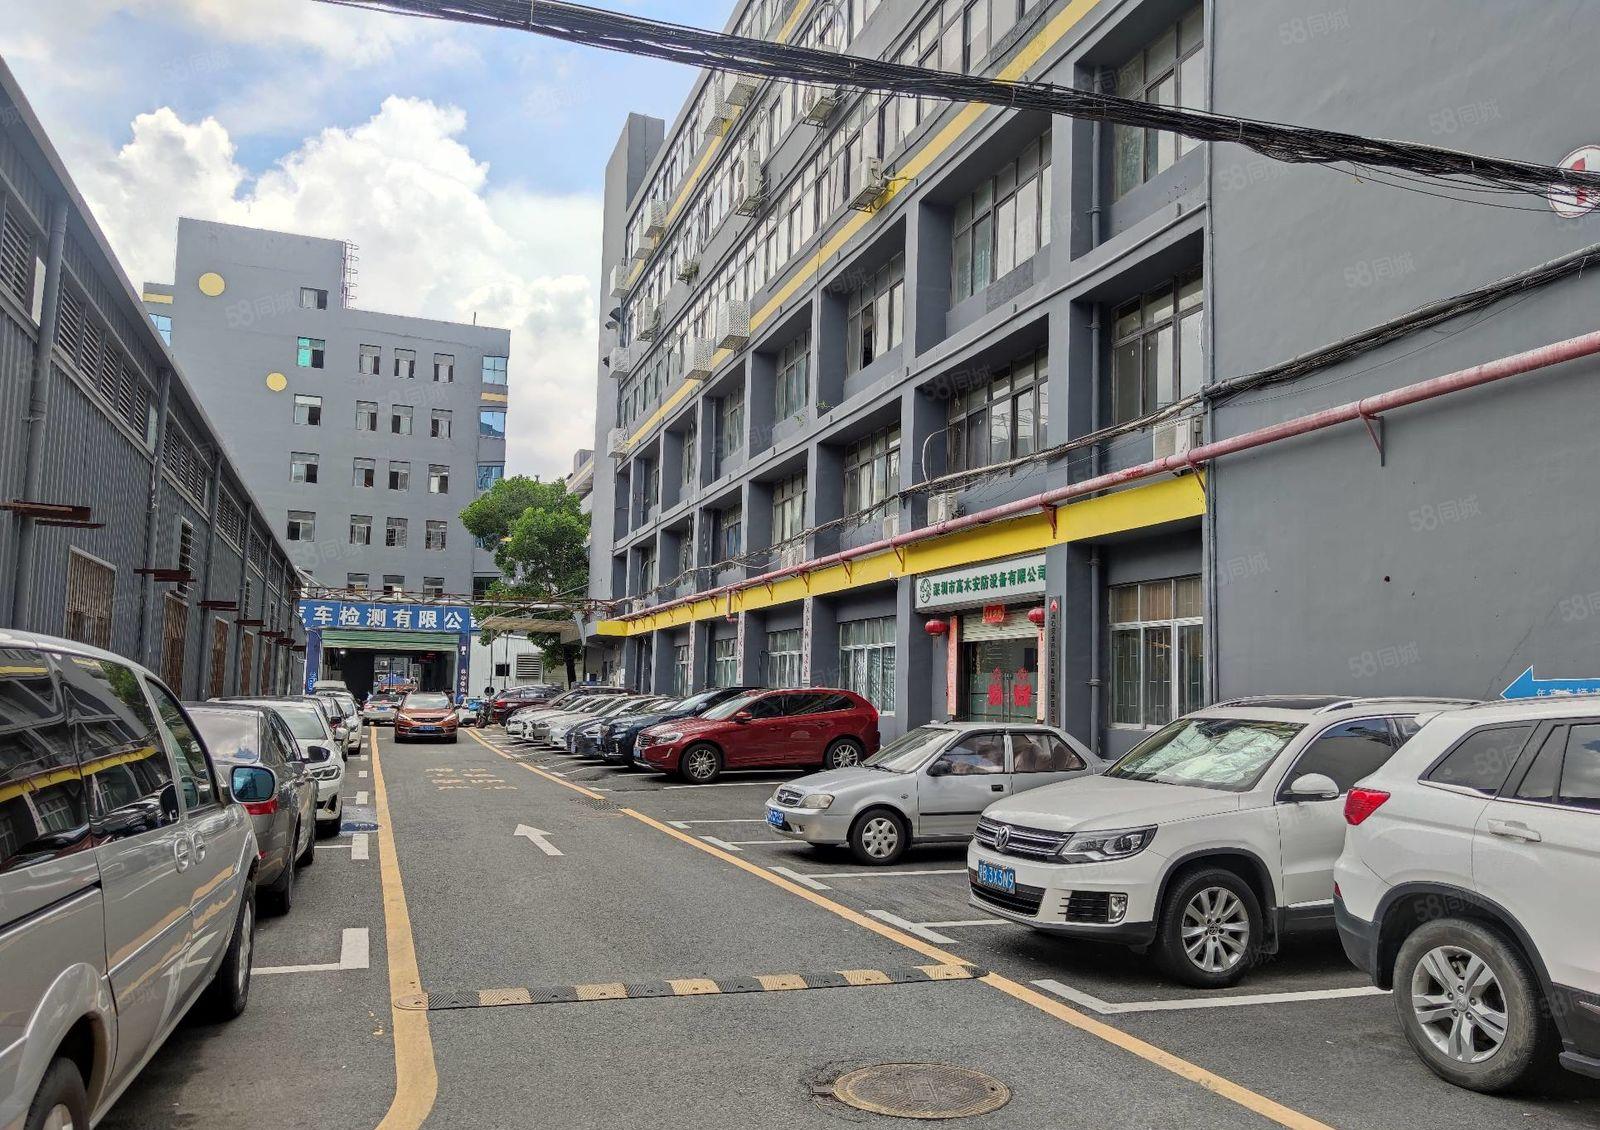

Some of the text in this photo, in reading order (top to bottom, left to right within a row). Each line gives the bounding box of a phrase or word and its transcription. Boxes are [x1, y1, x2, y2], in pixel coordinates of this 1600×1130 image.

[932, 565, 1046, 597] 深圳市高木安防设备有限公司
